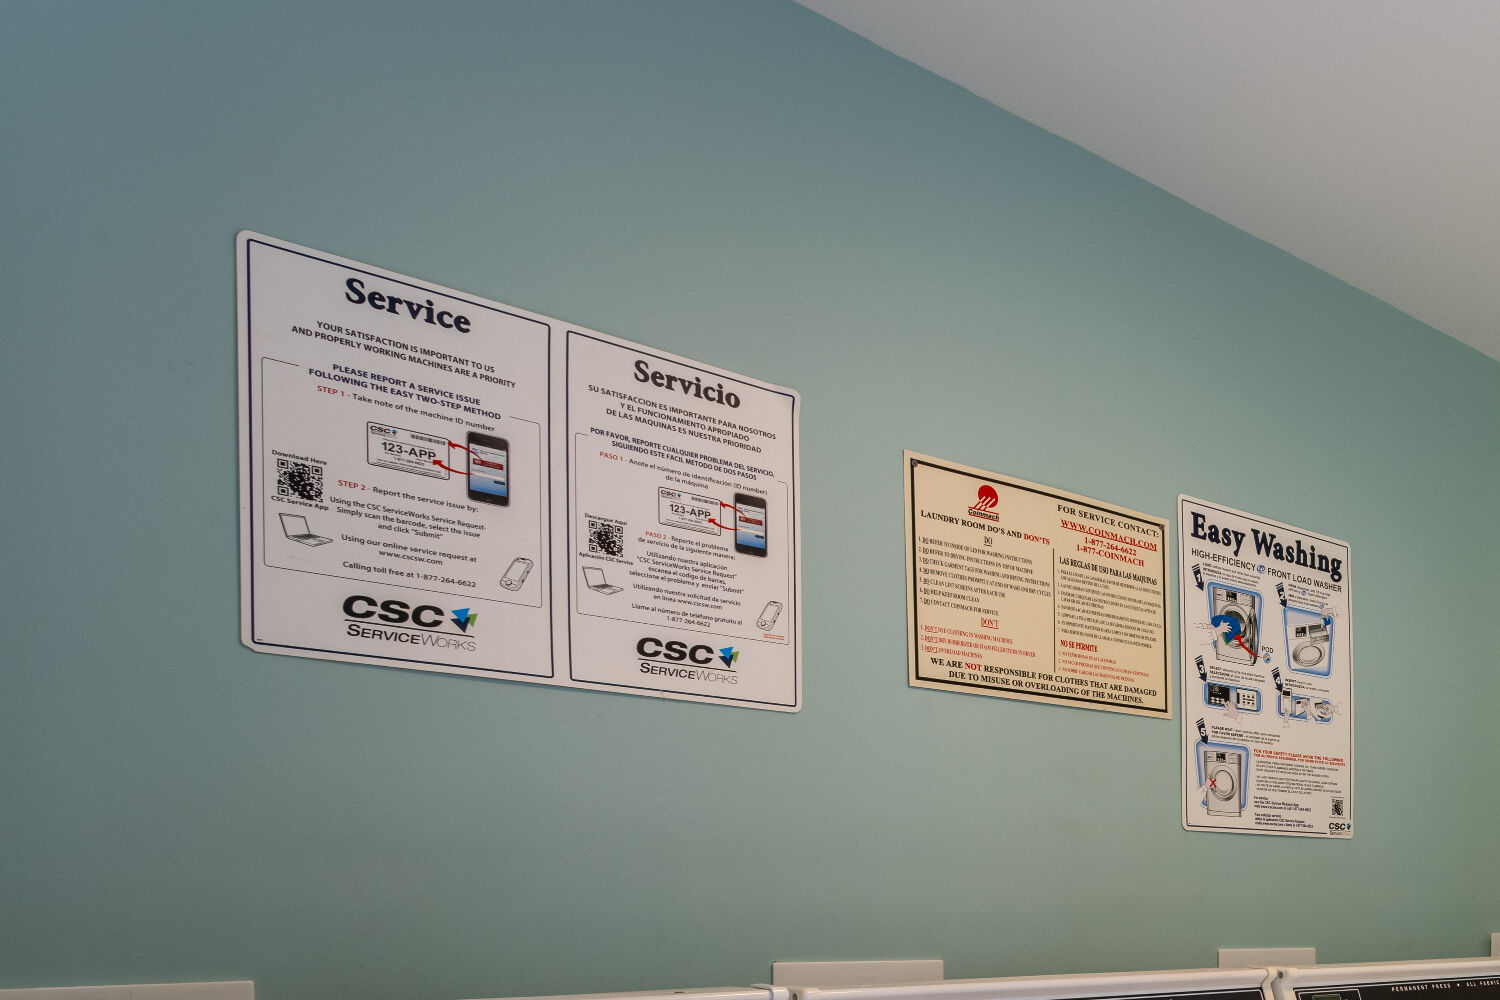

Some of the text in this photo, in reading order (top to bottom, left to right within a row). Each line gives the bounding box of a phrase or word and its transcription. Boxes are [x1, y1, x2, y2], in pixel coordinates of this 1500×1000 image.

[345, 278, 470, 333] Service
[292, 326, 313, 336] AND
[315, 331, 361, 348] PROPERLY
[364, 344, 406, 360] WORKING
[409, 355, 453, 372] MACHINES
[455, 367, 470, 377] ARE
[480, 373, 515, 388] PRIORITY
[317, 321, 495, 373] YOUR SATISFACTION IS IMPORTANT TO US
[309, 368, 501, 420] FOLLOWING THE EASY TWO-STEP METHOD
[333, 364, 368, 378] PLEASE
[371, 373, 407, 387] REPORT
[418, 385, 454, 399] SERVICE
[456, 394, 480, 406] ISSUE
[634, 360, 740, 408] Servicio
[601, 388, 657, 408] SATISFACCION
[659, 403, 668, 411] ES
[669, 406, 717, 425] IMPORTANTE
[718, 419, 737, 429] PARA
[738, 425, 776, 440] NOSOTROS
[381, 442, 436, 461] 123-APP
[669, 504, 711, 519] 123-APP
[921, 510, 959, 524] LAUNDRY
[961, 519, 985, 530] ROOM
[1006, 530, 1022, 538] AND
[968, 508, 1000, 520] Coinmach
[1057, 504, 1159, 538] FOR SERVICE CONTACT:
[1060, 519, 1158, 552] WWW.COINMACH.COM
[1085, 537, 1136, 556] 1-877-264-6622
[1190, 511, 1246, 557] Easy
[1251, 528, 1343, 583] Washing
[379, 550, 443, 565] www.cscsw.com
[1077, 544, 1144, 567] 1-877-COINMACH
[1191, 548, 1256, 571] HIGH-EFFICIENCY
[1268, 568, 1291, 579] FRONT
[1293, 574, 1312, 585] LOAD
[1314, 580, 1342, 592] WASHER
[342, 595, 444, 628] CSC
[636, 637, 714, 665] CSC
[931, 657, 944, 666] WE
[946, 660, 963, 668] ARE
[965, 663, 981, 671] NOT
[984, 665, 1036, 679] RESPONSIBLE
[1038, 673, 1053, 681] FOR
[1055, 676, 1088, 686] CLOTHES
[1090, 681, 1108, 689] THAT
[1124, 686, 1157, 696] DAMAGED
[949, 671, 965, 679] DUE
[981, 675, 1010, 685] MISUSE
[1025, 682, 1079, 695] OVERLOADING
[1327, 822, 1346, 830] CSC
